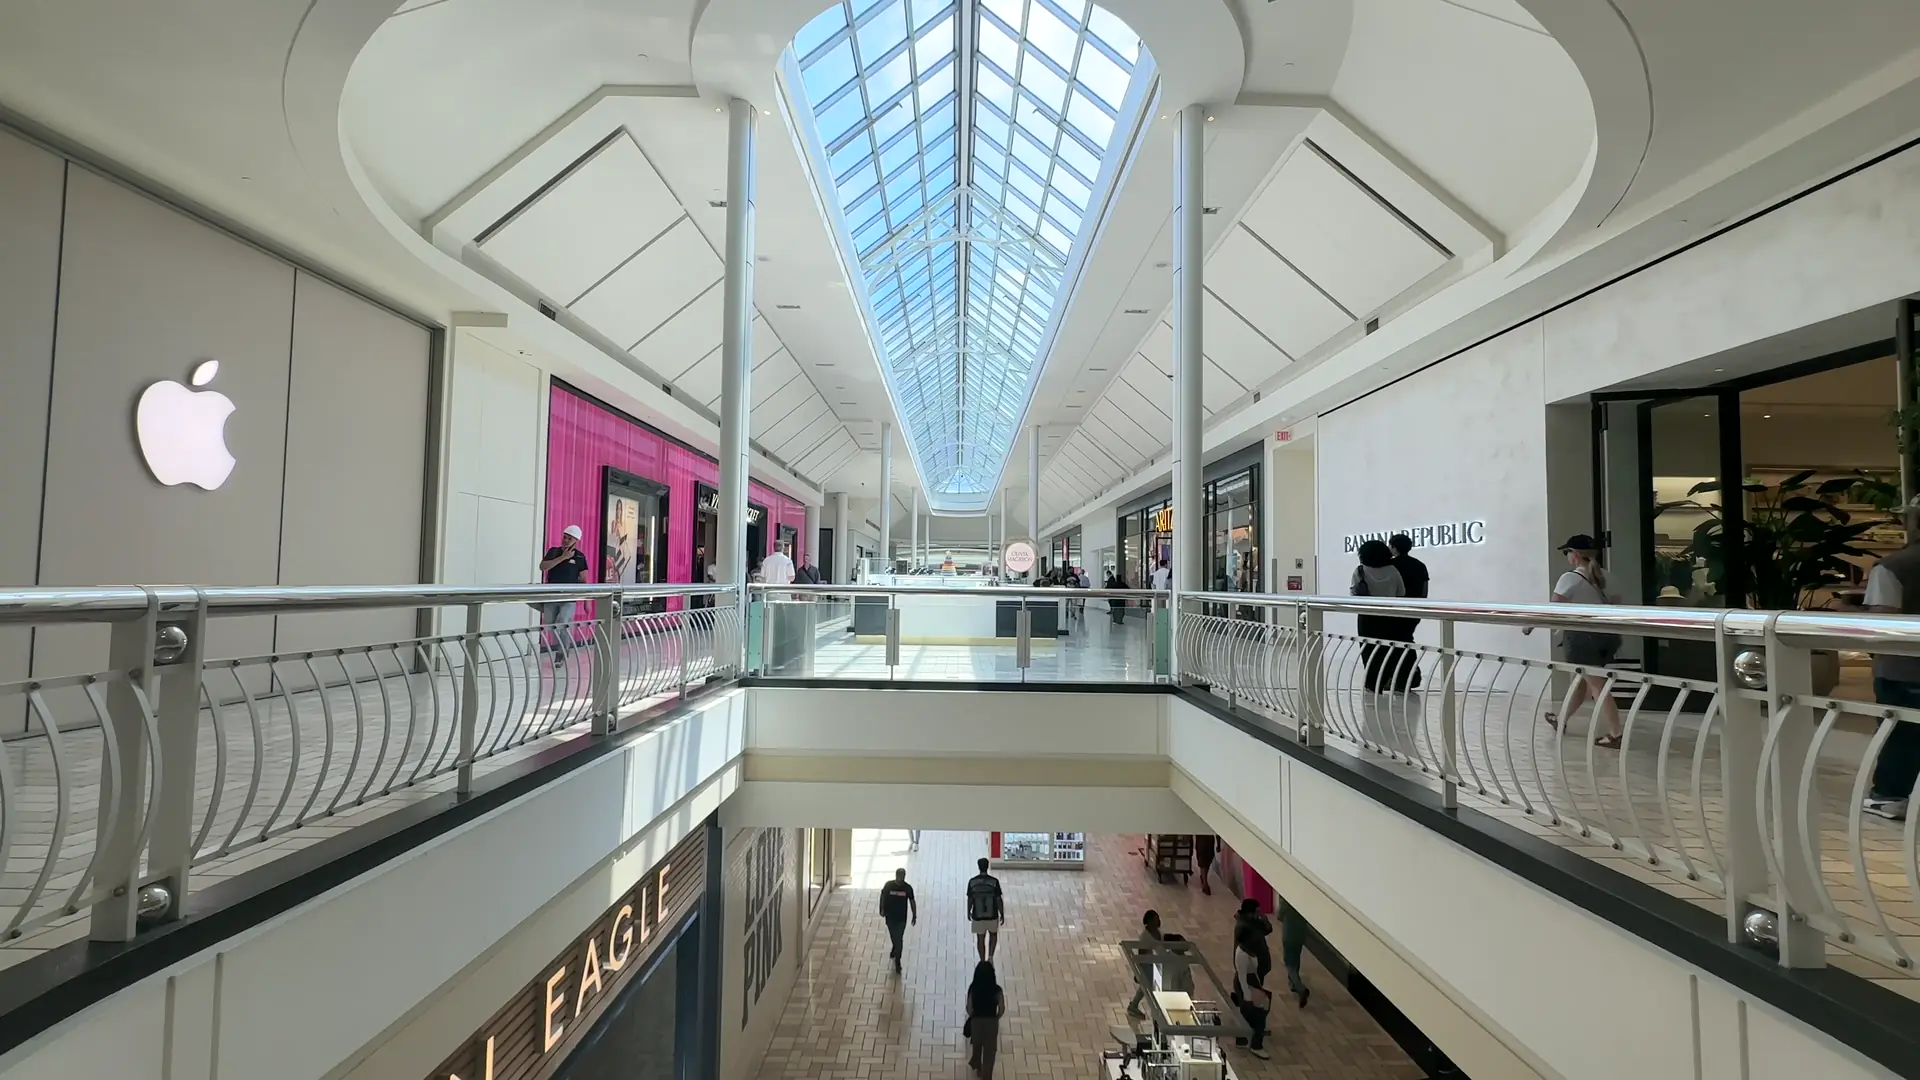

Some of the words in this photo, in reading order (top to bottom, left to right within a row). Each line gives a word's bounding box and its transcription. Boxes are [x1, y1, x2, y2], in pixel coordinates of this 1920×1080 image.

[543, 863, 672, 1054] EAGLE
[741, 878, 784, 1033] PINK
[744, 827, 785, 937] LOVE
